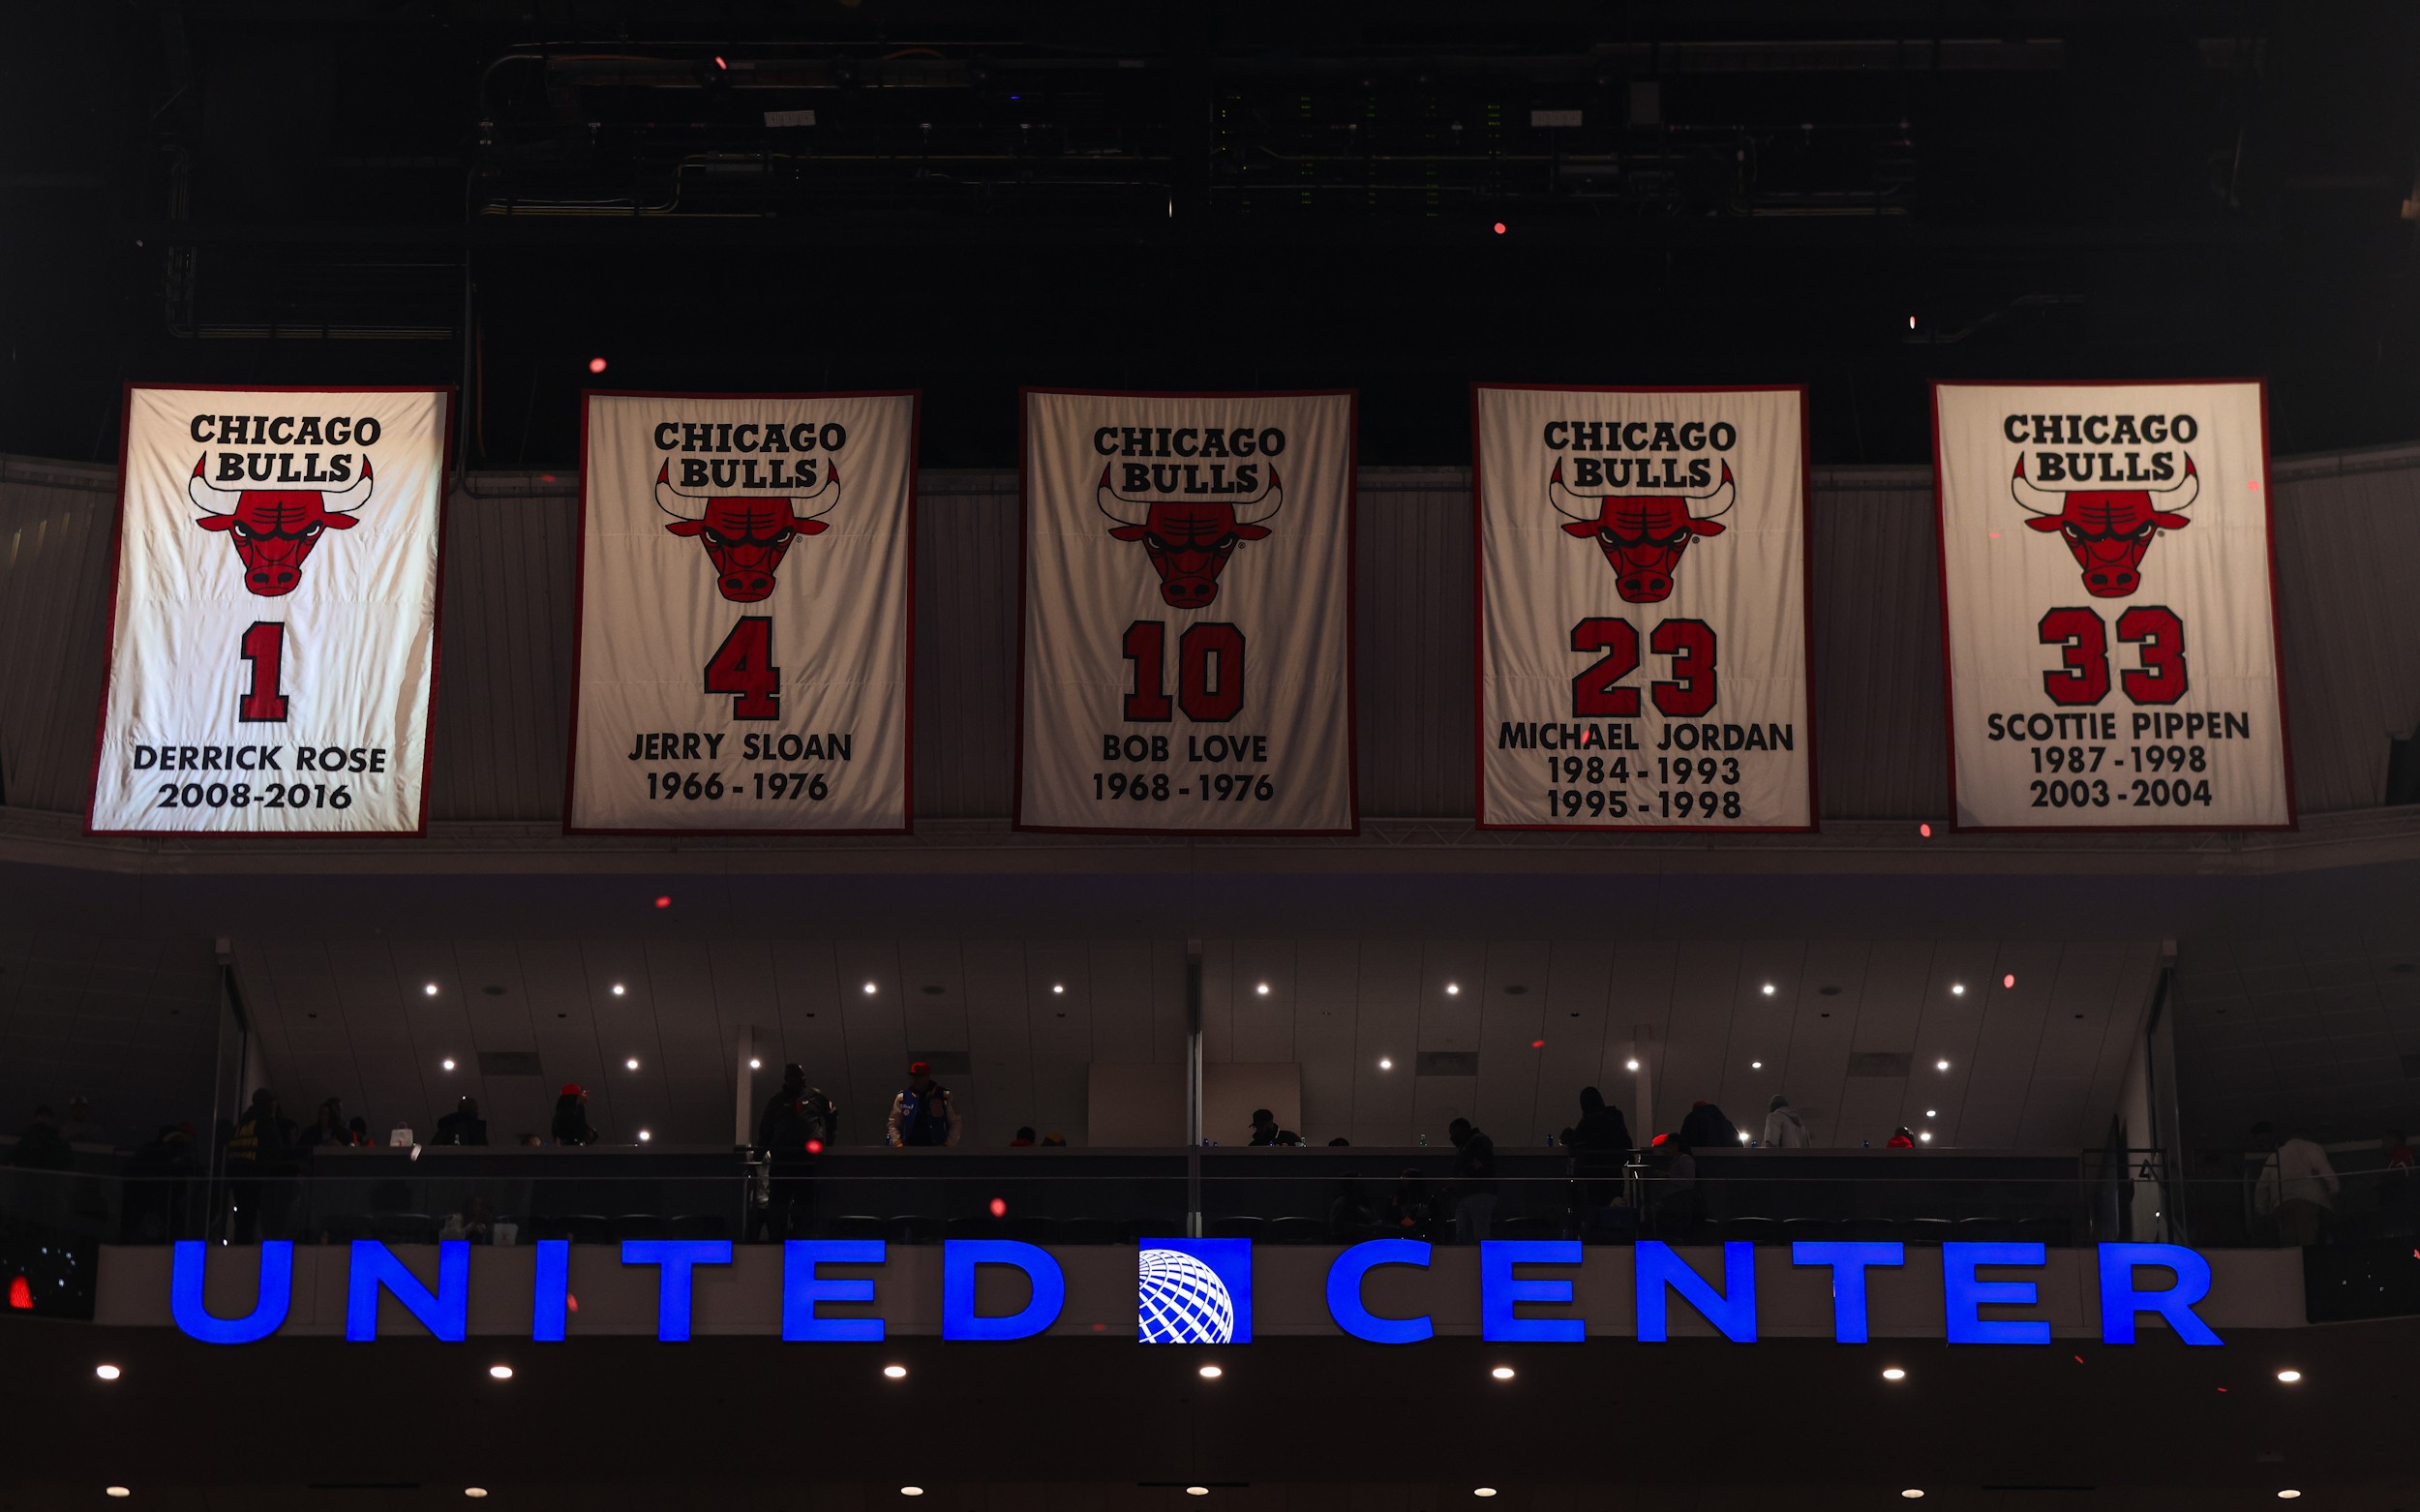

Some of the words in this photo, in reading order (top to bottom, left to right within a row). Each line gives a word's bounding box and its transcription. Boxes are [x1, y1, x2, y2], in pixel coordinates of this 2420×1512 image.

[190, 413, 381, 447] CHICAGO
[653, 421, 847, 454] CHICAGO
[1093, 426, 1286, 458] CHICAGO
[1543, 420, 1737, 452] CHICAGO
[2003, 413, 2198, 445] CHICAGO
[215, 452, 352, 483] BULLS
[680, 458, 818, 489] BULLS
[1121, 462, 1258, 495] BULLS
[1573, 457, 1711, 489] BULLS
[2036, 451, 2175, 482] BULLS
[238, 620, 290, 724] 1
[703, 615, 781, 722] 4
[1122, 620, 1247, 723] 10
[1569, 616, 1718, 719] 23
[2037, 604, 2190, 708] 33
[1497, 721, 1640, 751] MICHAEL
[1656, 722, 1794, 752] JORDAN
[1987, 712, 2117, 741] SCOTTIE
[2132, 711, 2251, 741] PIPPEN
[133, 744, 284, 771] DERRICK
[295, 745, 386, 773] ROSE
[627, 732, 726, 762] JERRY
[741, 733, 852, 762] SLOAN
[1103, 734, 1169, 763] BOB
[1188, 735, 1268, 764] LOVE
[156, 780, 352, 811] 2008-2016
[170, 1237, 1066, 1345] UNITED
[1325, 1237, 2225, 1346] CENTER
